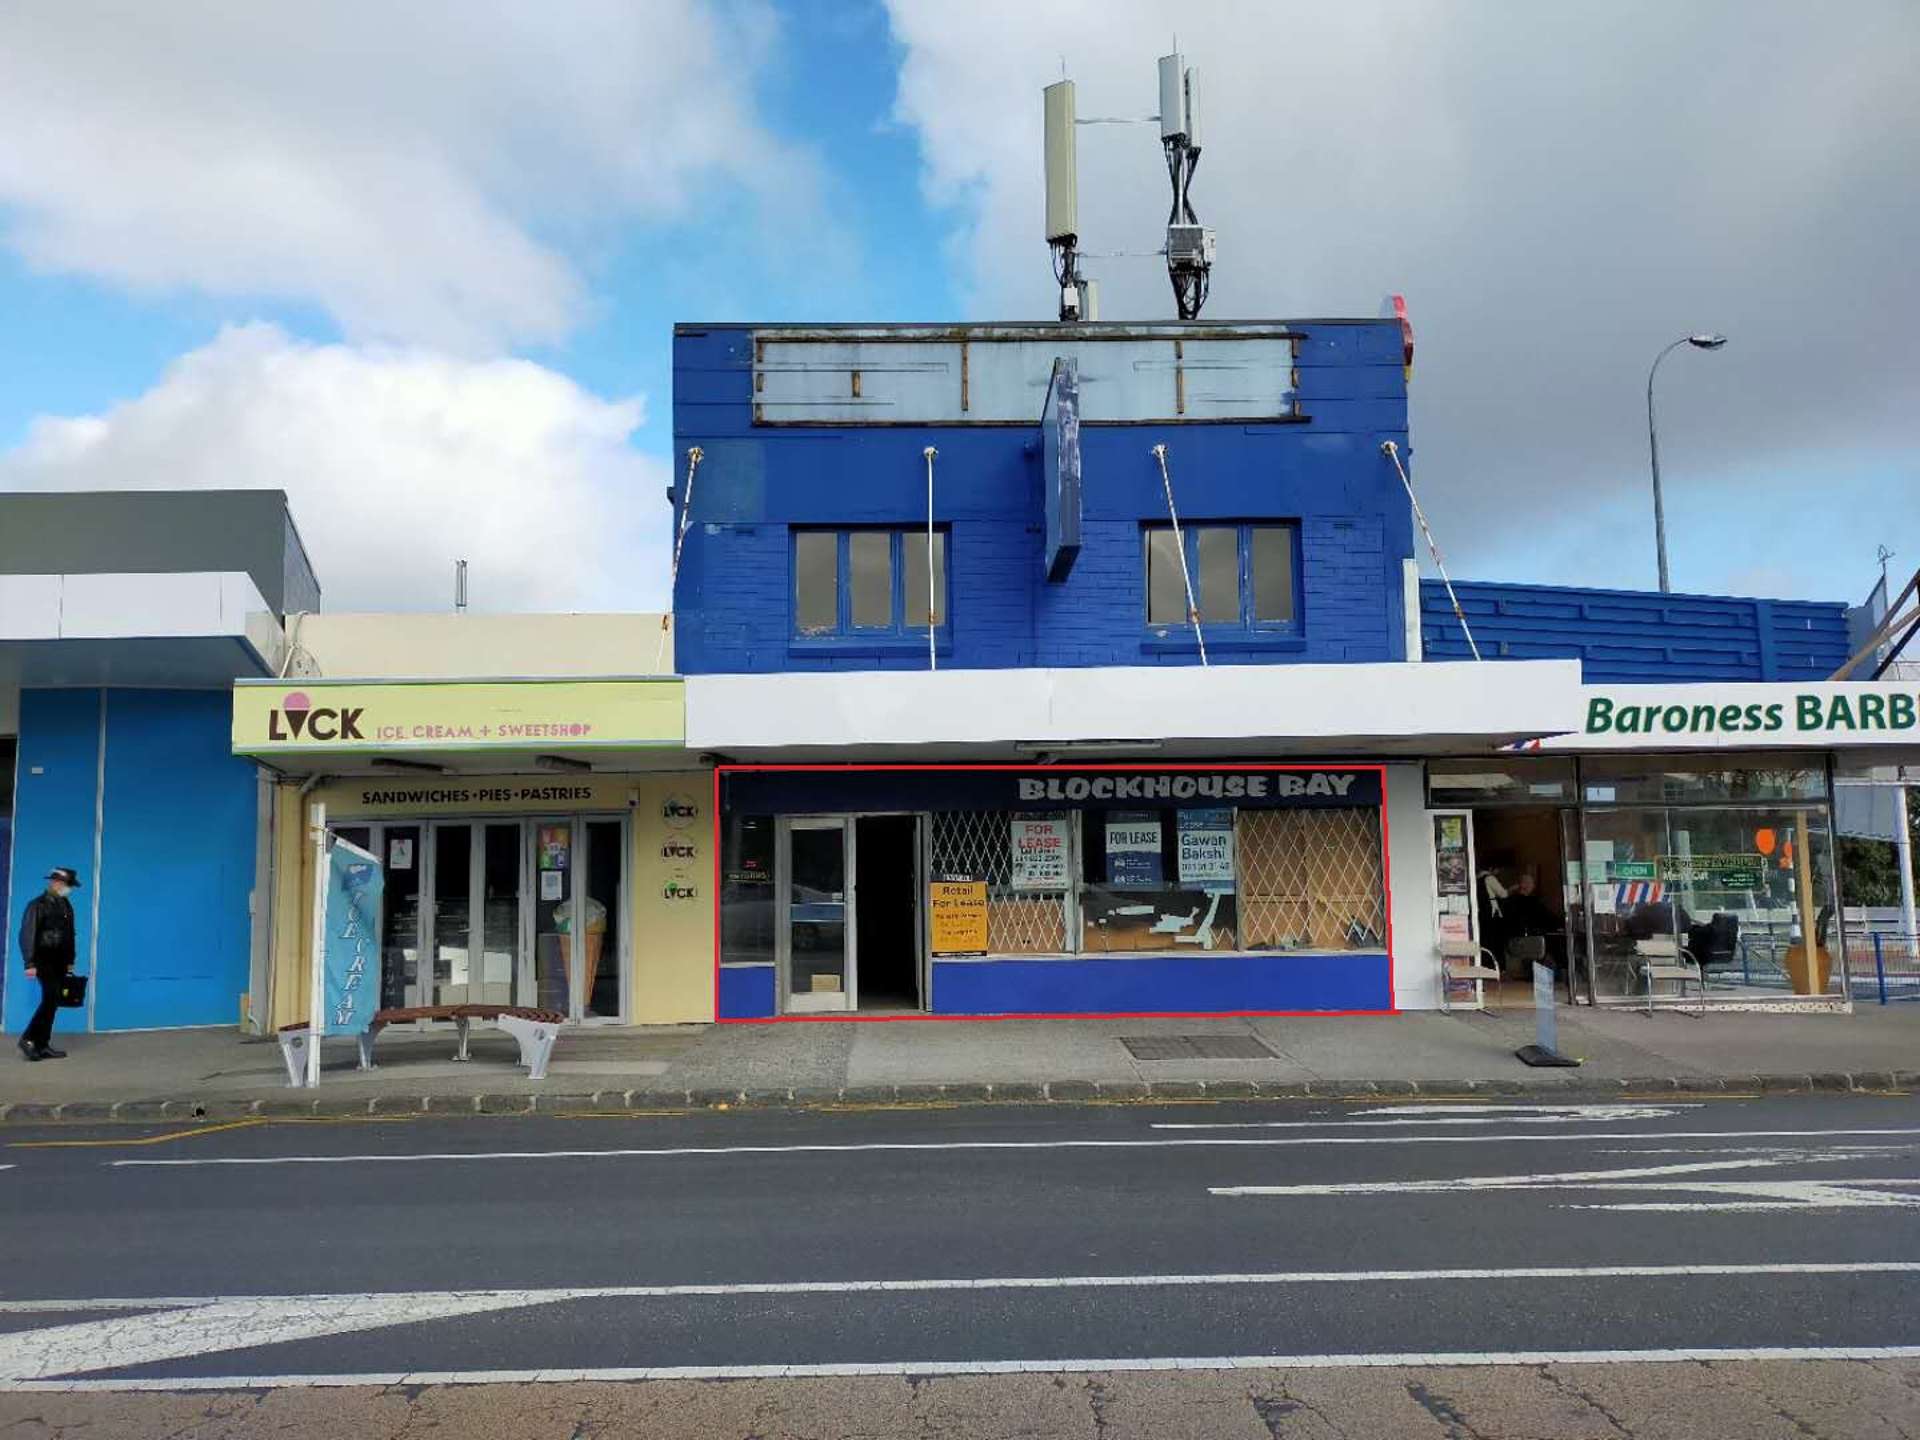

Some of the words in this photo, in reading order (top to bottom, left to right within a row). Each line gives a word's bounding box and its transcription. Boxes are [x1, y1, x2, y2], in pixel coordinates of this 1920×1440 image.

[1585, 697, 1783, 734] Baroness
[1796, 693, 1920, 731] BARB
[377, 726, 404, 739] ICE
[413, 725, 473, 738] CREAM
[498, 723, 591, 737] SWEETSHOP
[1019, 776, 1268, 800] BLOCKHOUSE
[1278, 773, 1355, 797] BAY
[362, 790, 469, 804] SANDWICHES
[479, 788, 511, 801] PIES
[521, 787, 591, 800] PASTRIES
[1025, 824, 1053, 834] FOR
[1018, 837, 1062, 848] LEASE
[1110, 831, 1127, 844] FOR
[1129, 831, 1157, 844] LEASE
[1622, 867, 1648, 875] OPEN
[943, 886, 973, 895] Retail
